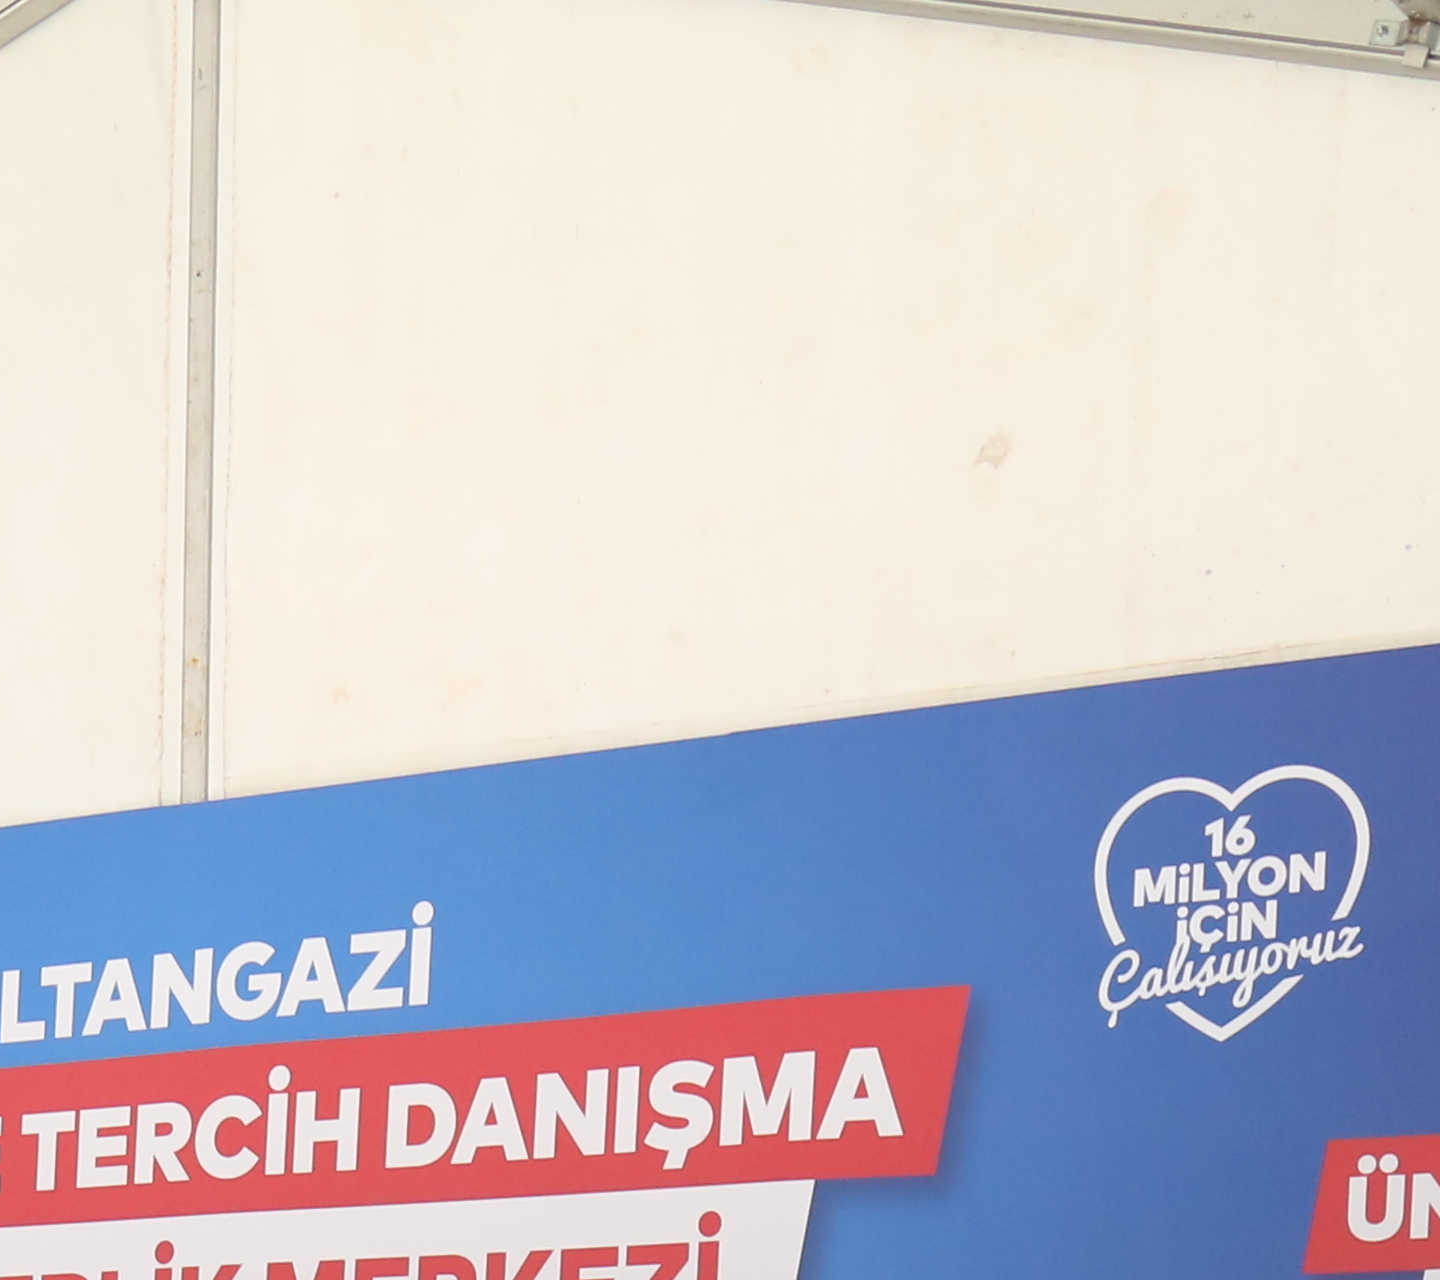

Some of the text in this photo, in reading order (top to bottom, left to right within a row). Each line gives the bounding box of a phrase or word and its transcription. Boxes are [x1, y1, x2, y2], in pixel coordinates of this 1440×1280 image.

[1204, 814, 1256, 858] 16
[1098, 925, 1364, 1029] Çalışıyoruz
[20, 1064, 361, 1192] TERCİH
[384, 1045, 905, 1170] DANIŞMA
